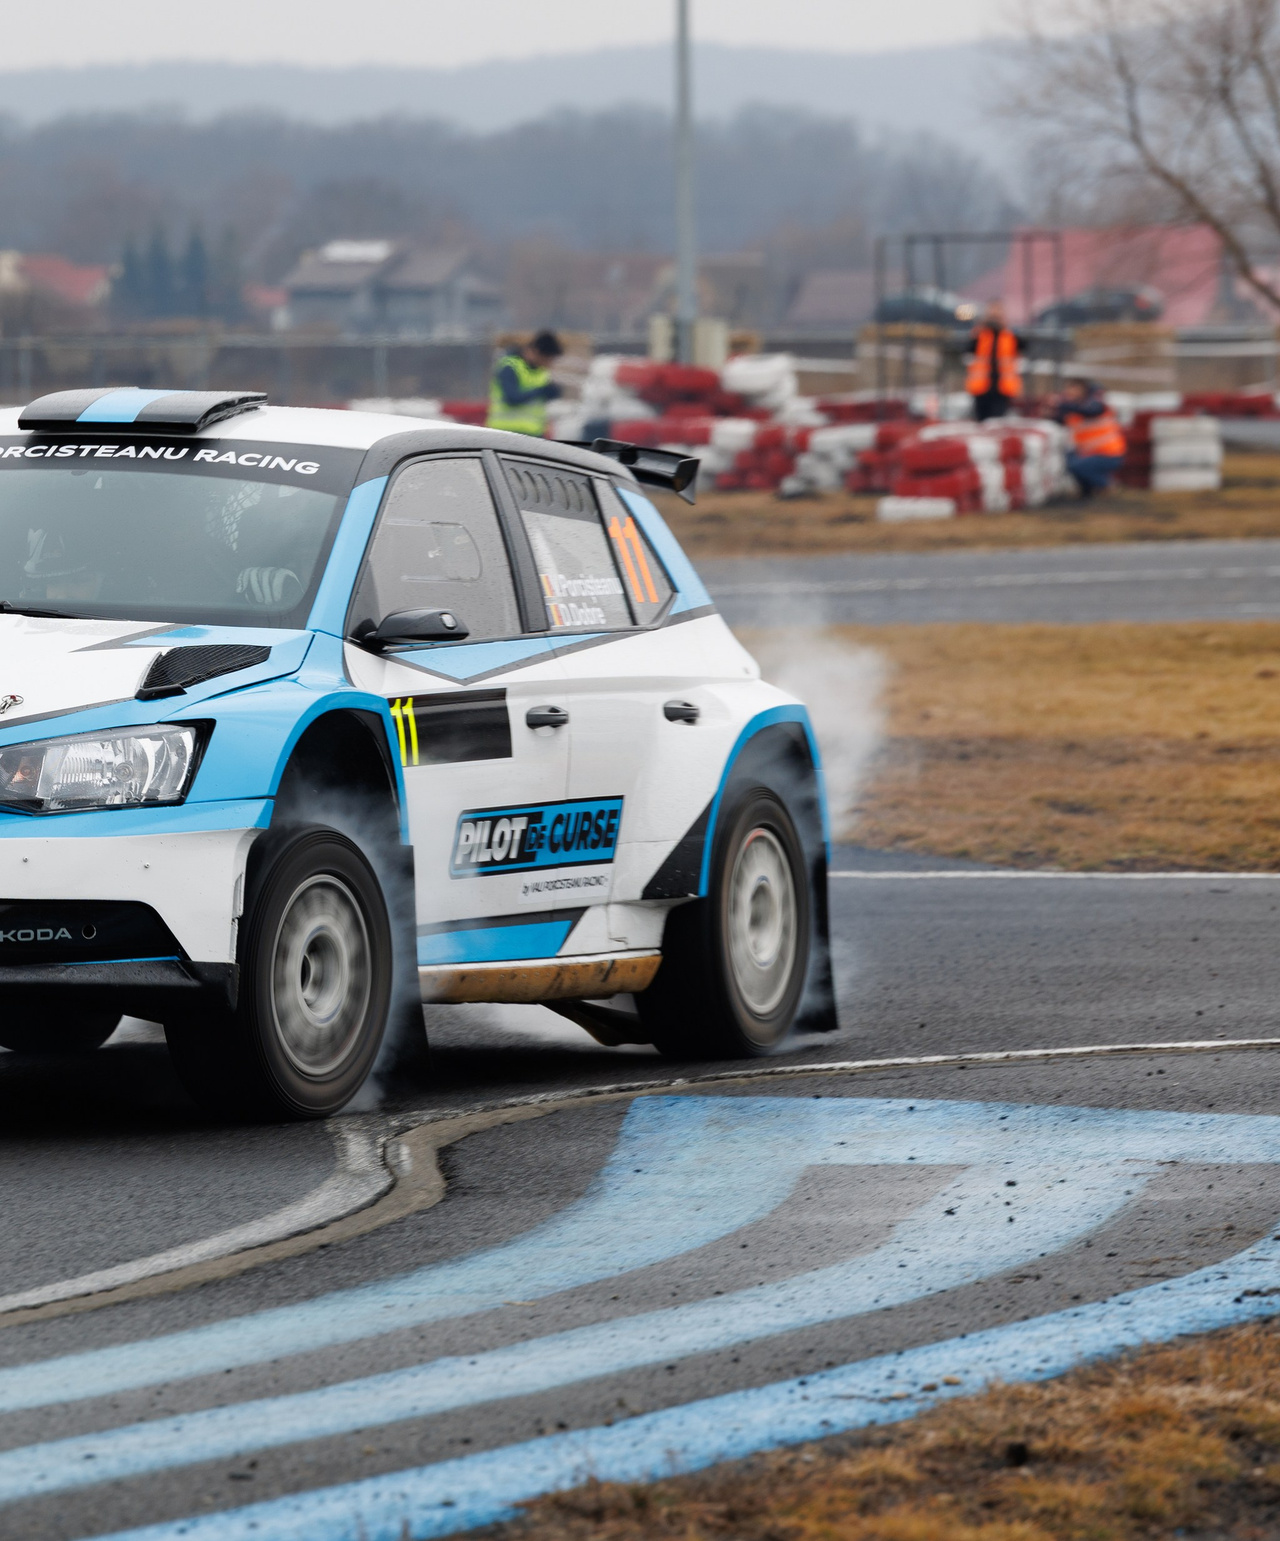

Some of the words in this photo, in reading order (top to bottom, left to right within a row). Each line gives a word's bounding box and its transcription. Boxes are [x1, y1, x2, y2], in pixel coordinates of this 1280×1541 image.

[193, 449, 321, 475] RACING
[607, 516, 659, 603] 11
[389, 697, 420, 767] 11
[454, 816, 529, 865] PILOT
[525, 824, 548, 851] DE
[549, 808, 620, 854] CURSE
